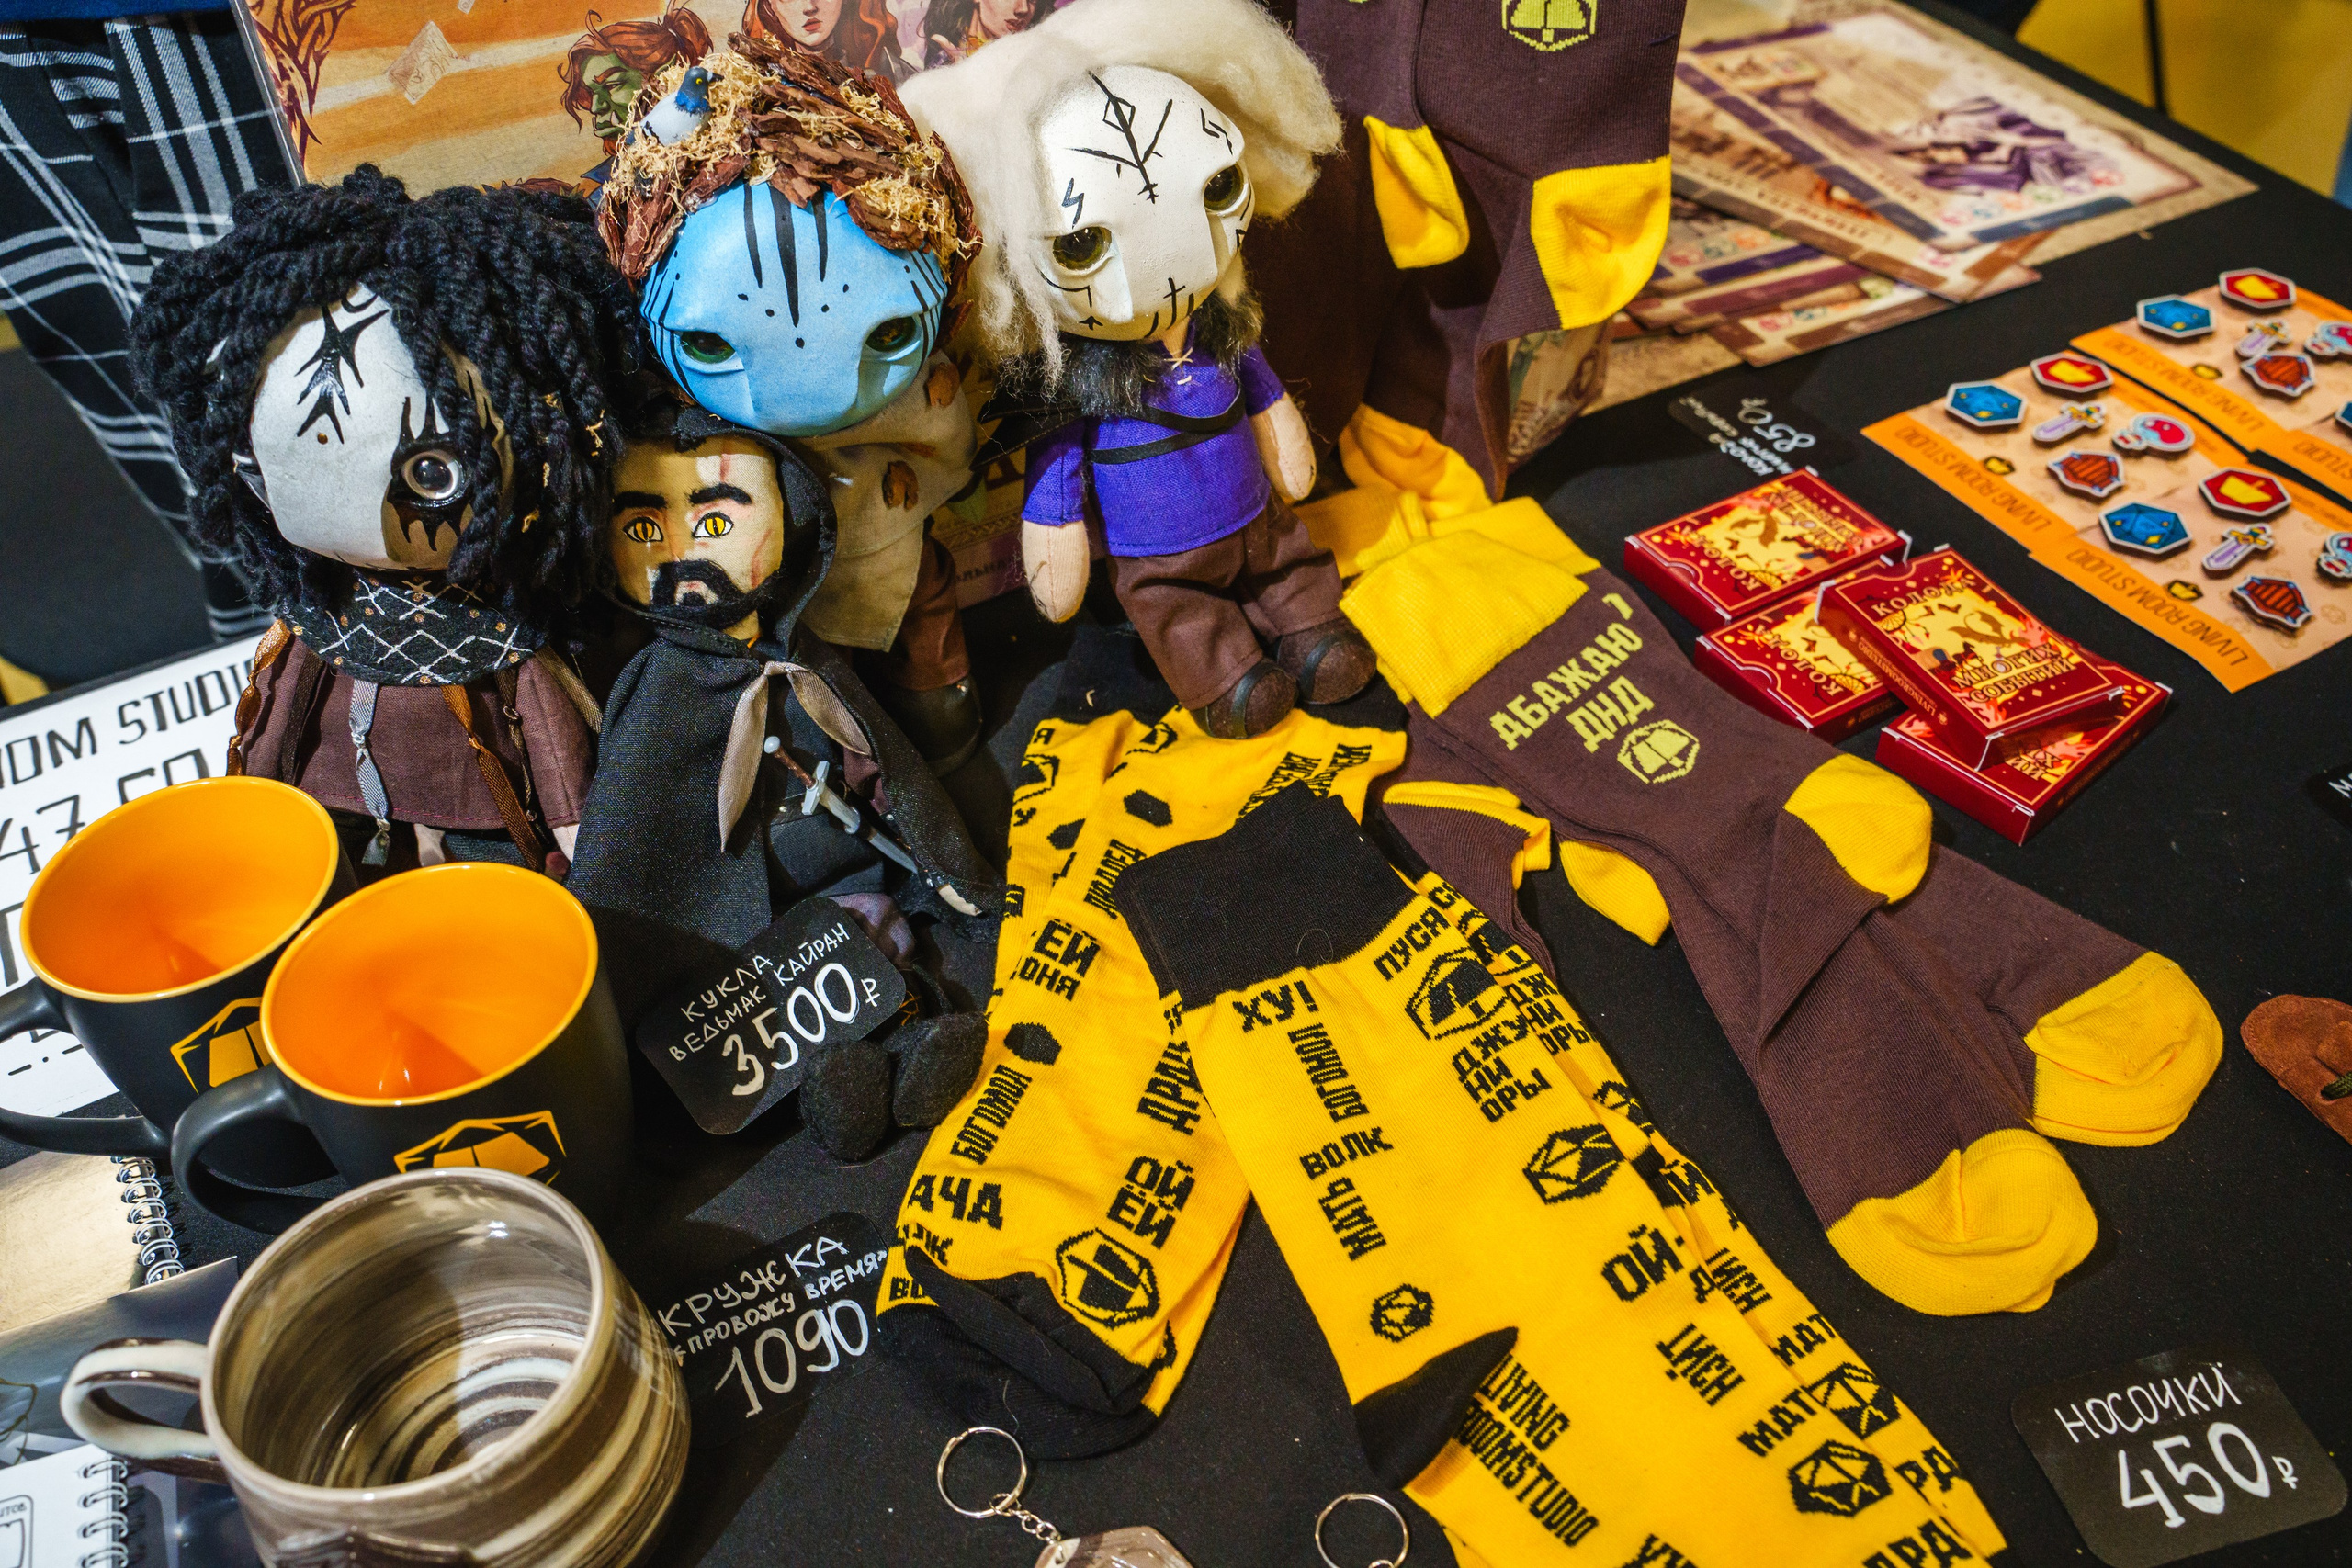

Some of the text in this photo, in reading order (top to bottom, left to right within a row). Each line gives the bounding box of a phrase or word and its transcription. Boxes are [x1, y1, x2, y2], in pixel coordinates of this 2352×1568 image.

[1894, 425, 2052, 533] LIVING ROOM STUDIO
[1680, 525, 1762, 592] КОЛОДА
[1871, 576, 1977, 617] КОЛОДА
[2064, 548, 2250, 670] LIVING ROOM STUDIO
[1755, 624, 1845, 697] КОЛОДА
[1951, 641, 2061, 690] МНОГИХ
[1969, 656, 2077, 704] СОБЫТИЙ
[118, 658, 254, 746] STUDI
[1565, 674, 1655, 754] ДНД
[1373, 905, 1453, 982] ПУСЯ
[668, 985, 768, 1062] ВЕДЬМАК
[680, 954, 775, 1023] КУКЛА
[1231, 979, 1320, 1033] ХУ!
[1287, 1021, 1371, 1125] БОГОМОЛ
[1452, 1013, 1530, 1084] ДЖУ
[1464, 1055, 1515, 1105] НИ
[949, 1064, 1034, 1166] БОГОМОЛ
[1480, 1067, 1553, 1123] ОРЫ
[1299, 1125, 1395, 1181] ВОЛК
[1317, 1176, 1388, 1262] МАТЬ
[657, 1236, 850, 1337] КРУЖКА
[714, 1298, 870, 1418] 1090
[1655, 1322, 1746, 1408] НЭЙТ
[2117, 1421, 2300, 1529] 450₽
